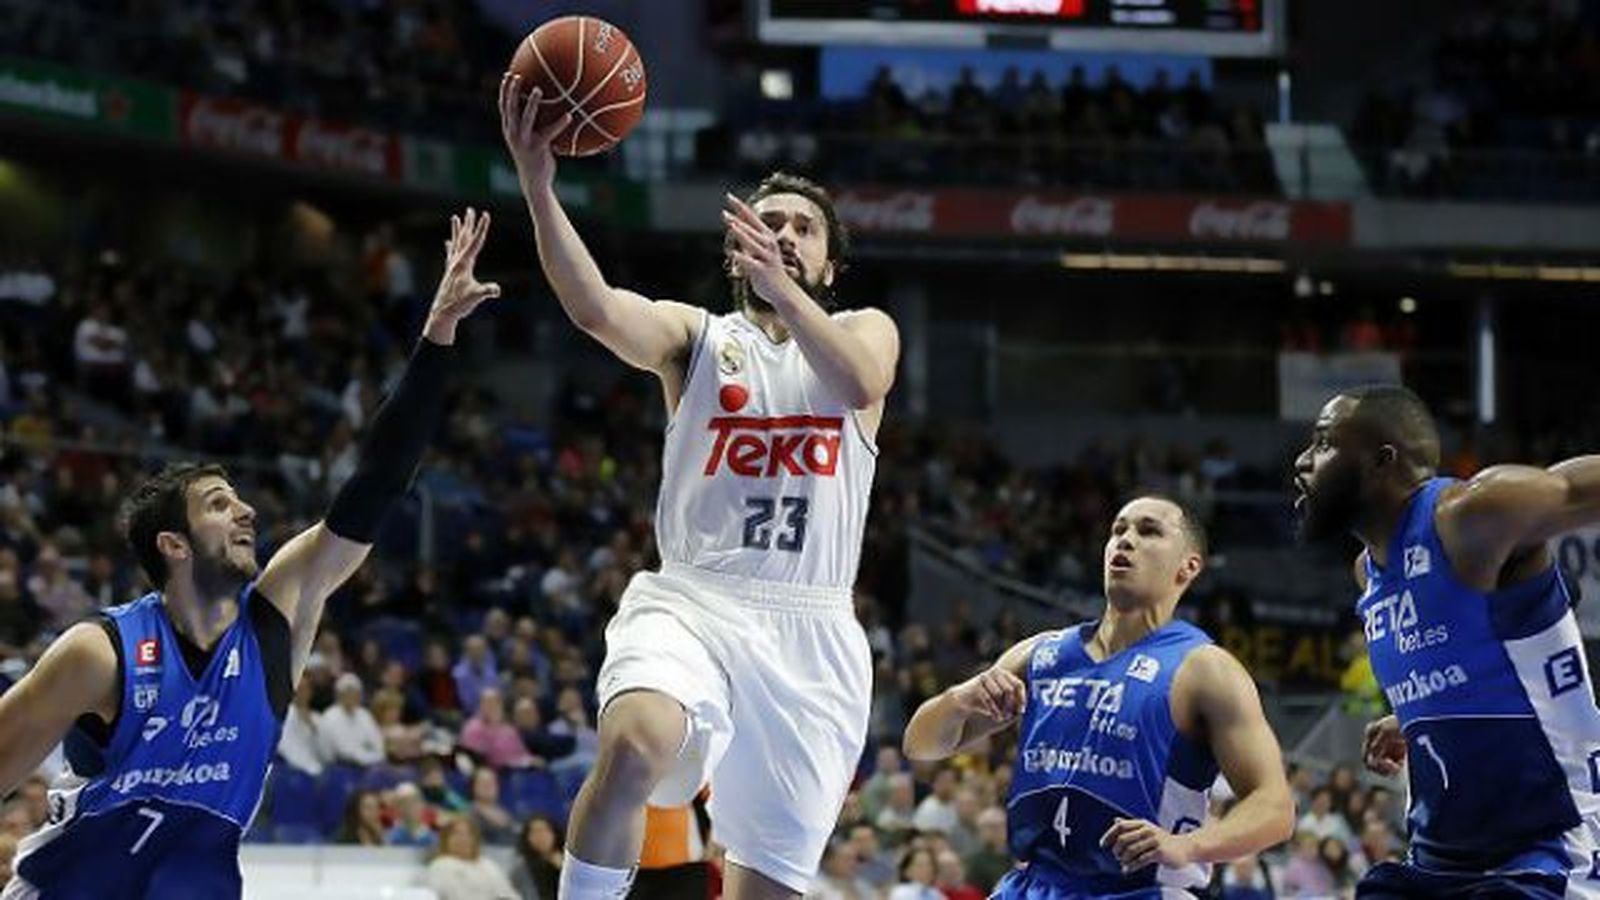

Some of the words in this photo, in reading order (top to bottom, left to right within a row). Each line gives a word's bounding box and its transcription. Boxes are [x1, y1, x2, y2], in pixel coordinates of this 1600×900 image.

[742, 496, 808, 553] 23
[1399, 624, 1449, 653] bet.es
[1032, 677, 1125, 715] RETA
[130, 807, 164, 854] 7
[1053, 796, 1072, 848] 4
